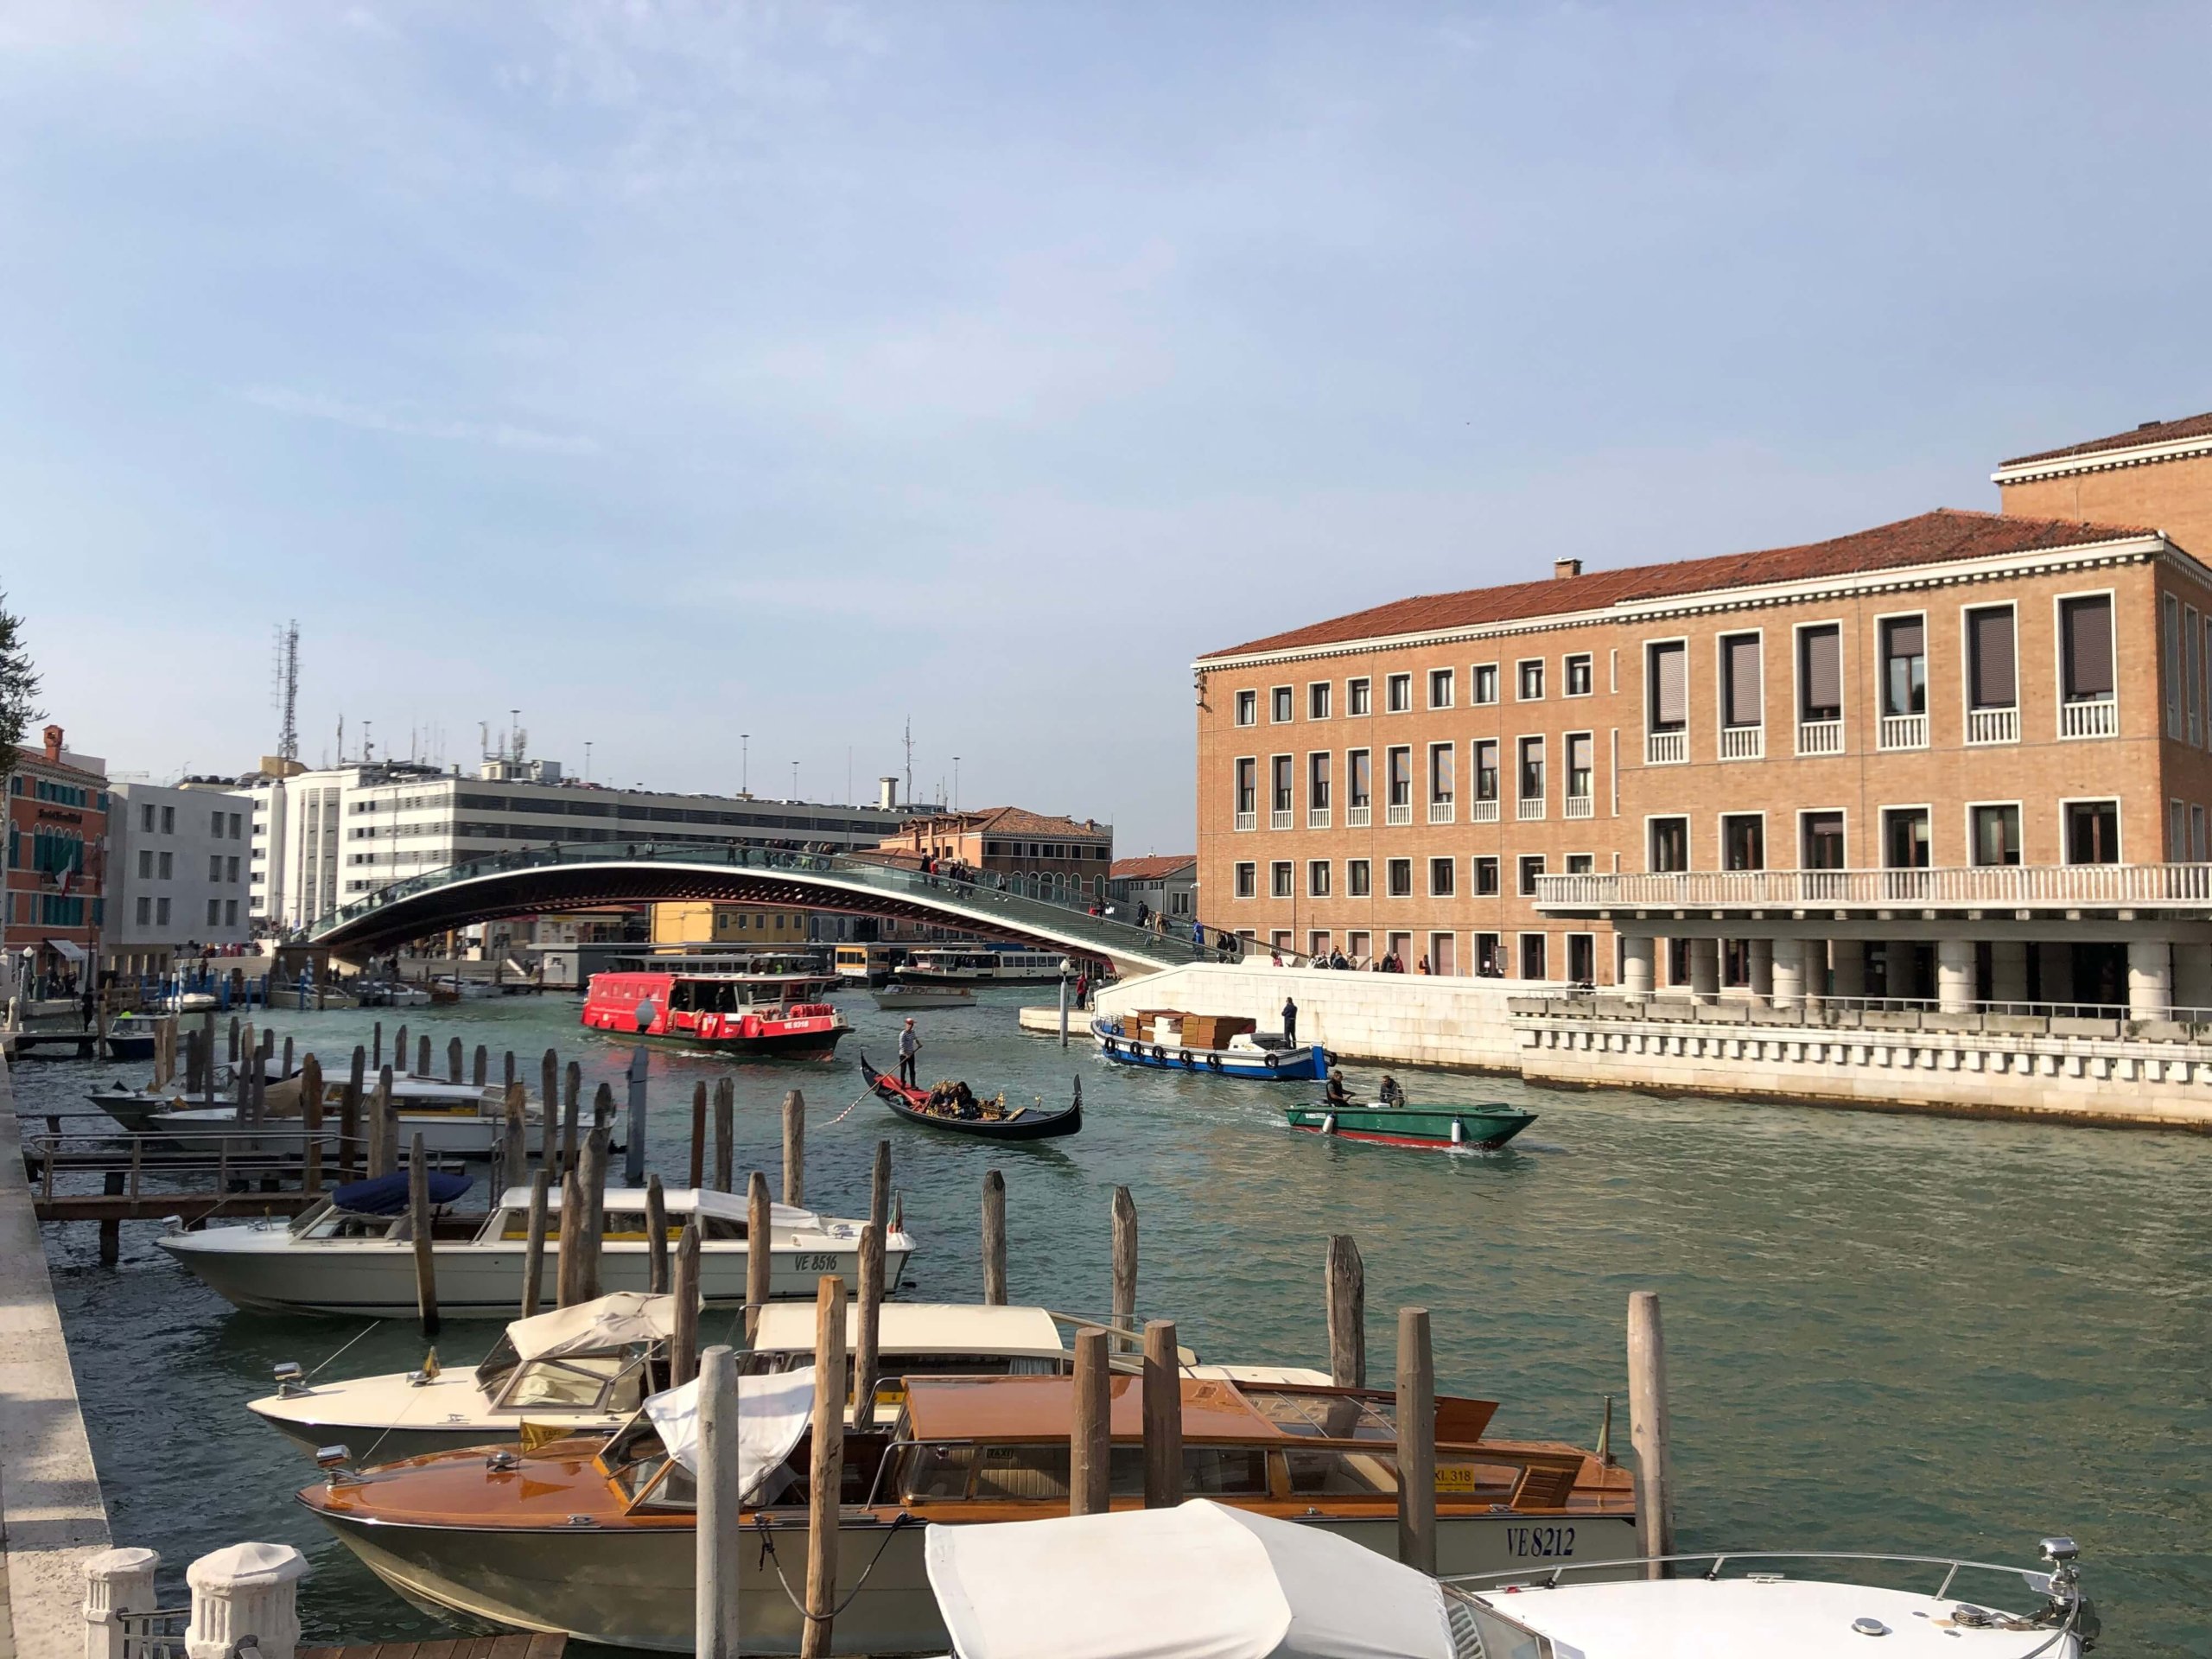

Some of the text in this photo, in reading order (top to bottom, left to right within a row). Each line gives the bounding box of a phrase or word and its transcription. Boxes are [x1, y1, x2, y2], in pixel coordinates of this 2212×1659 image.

[795, 1255, 837, 1271] VE 8516
[1451, 1470, 1471, 1482] 318
[1507, 1527, 1575, 1557] VE 8212
